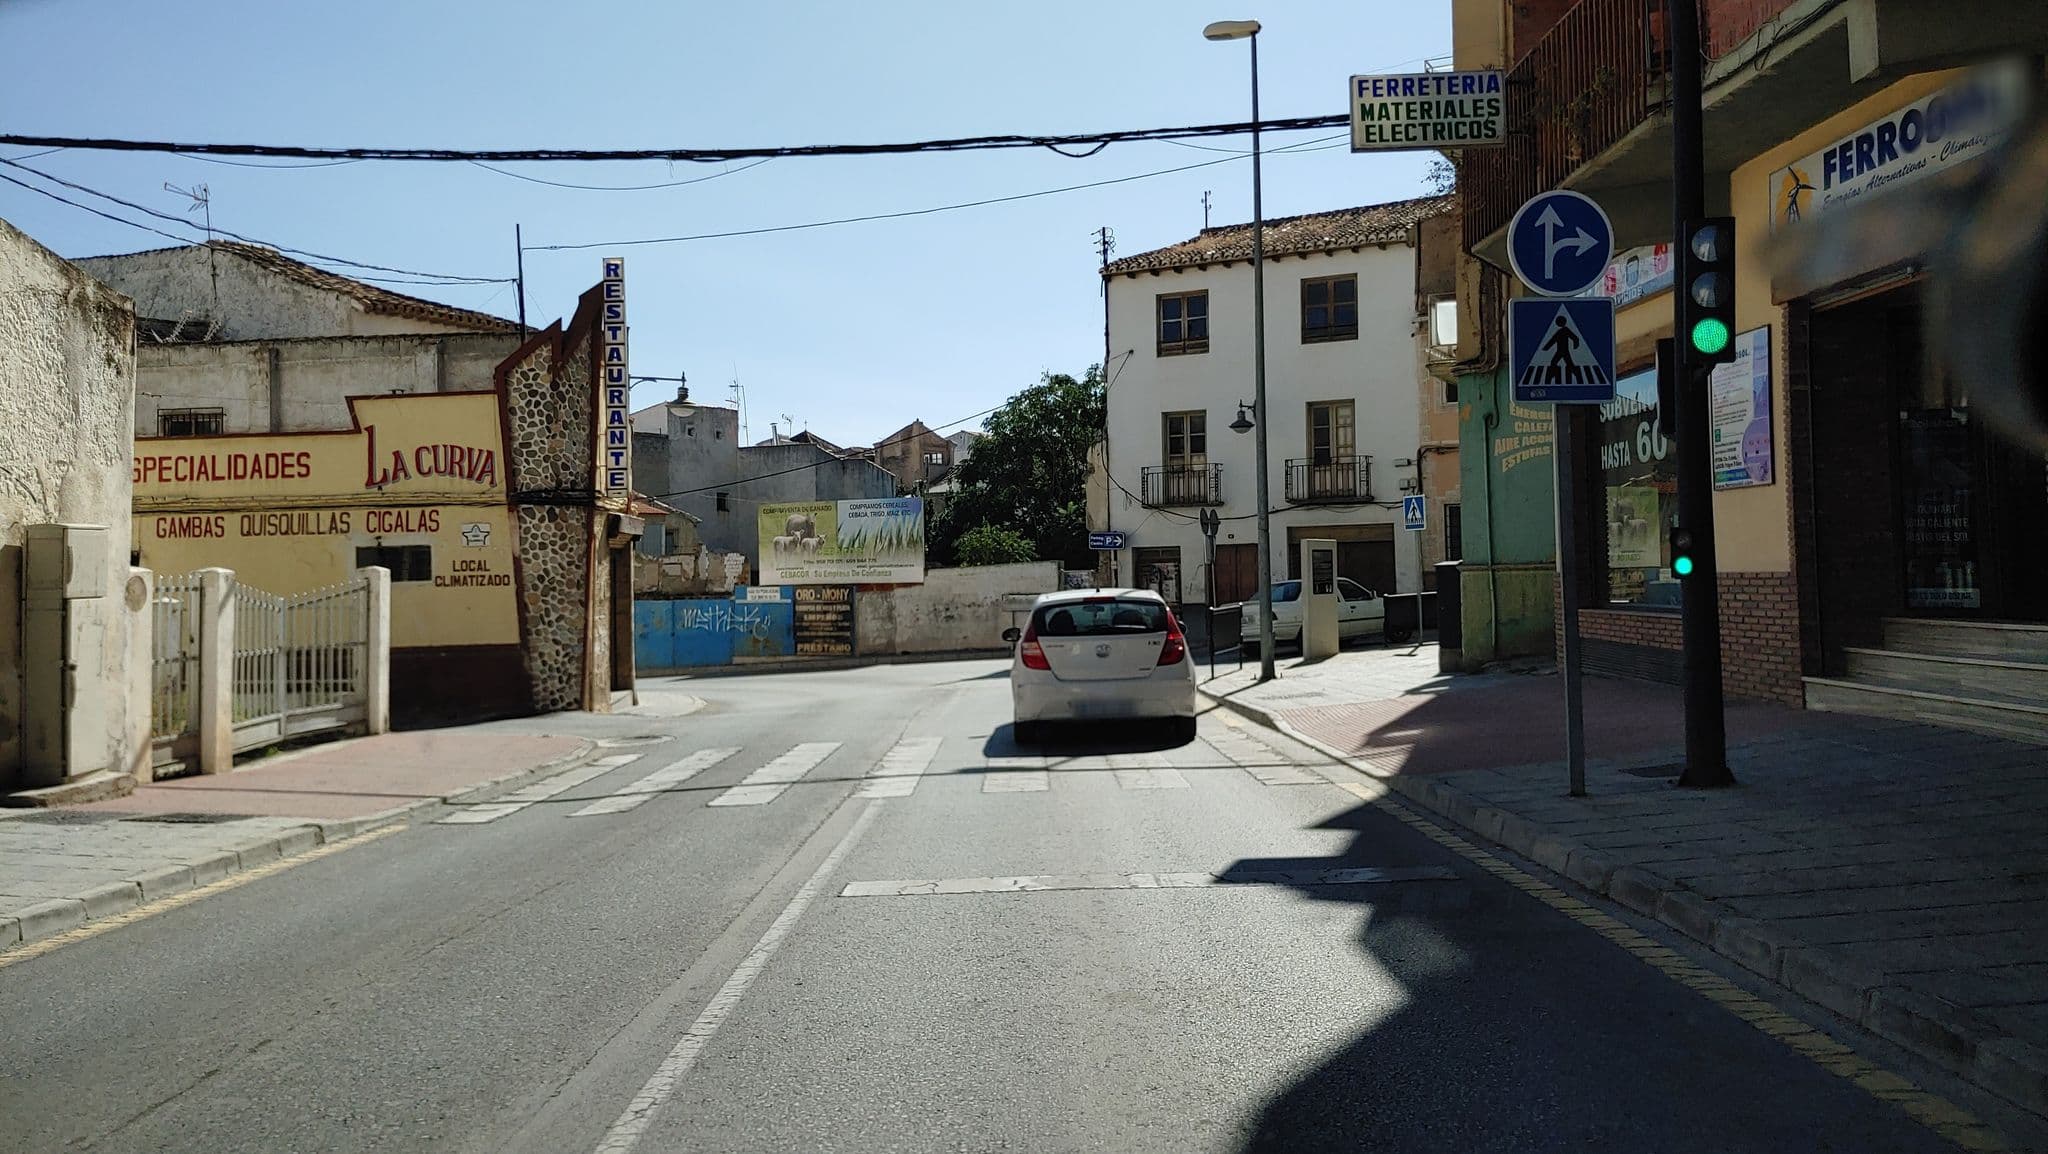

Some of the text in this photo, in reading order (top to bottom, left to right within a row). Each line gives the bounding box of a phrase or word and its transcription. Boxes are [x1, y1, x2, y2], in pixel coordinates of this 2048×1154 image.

[1357, 74, 1500, 99] FERRETERIA
[1360, 98, 1500, 122] MATERIALES
[1365, 119, 1497, 143] ELECTRICOS
[1866, 158, 1927, 191] Alternativas
[605, 262, 626, 487] RESTAURANTE
[364, 424, 498, 489] LA CURVA
[1494, 436, 1520, 456] AIRE
[1601, 440, 1631, 470] HASTA
[155, 509, 440, 539] GAMBAS QUISQUILLAS CIGALAS
[452, 559, 491, 572] LOCAL
[435, 573, 511, 588] CLIMATIZADO
[795, 588, 850, 600] ORO MONY
